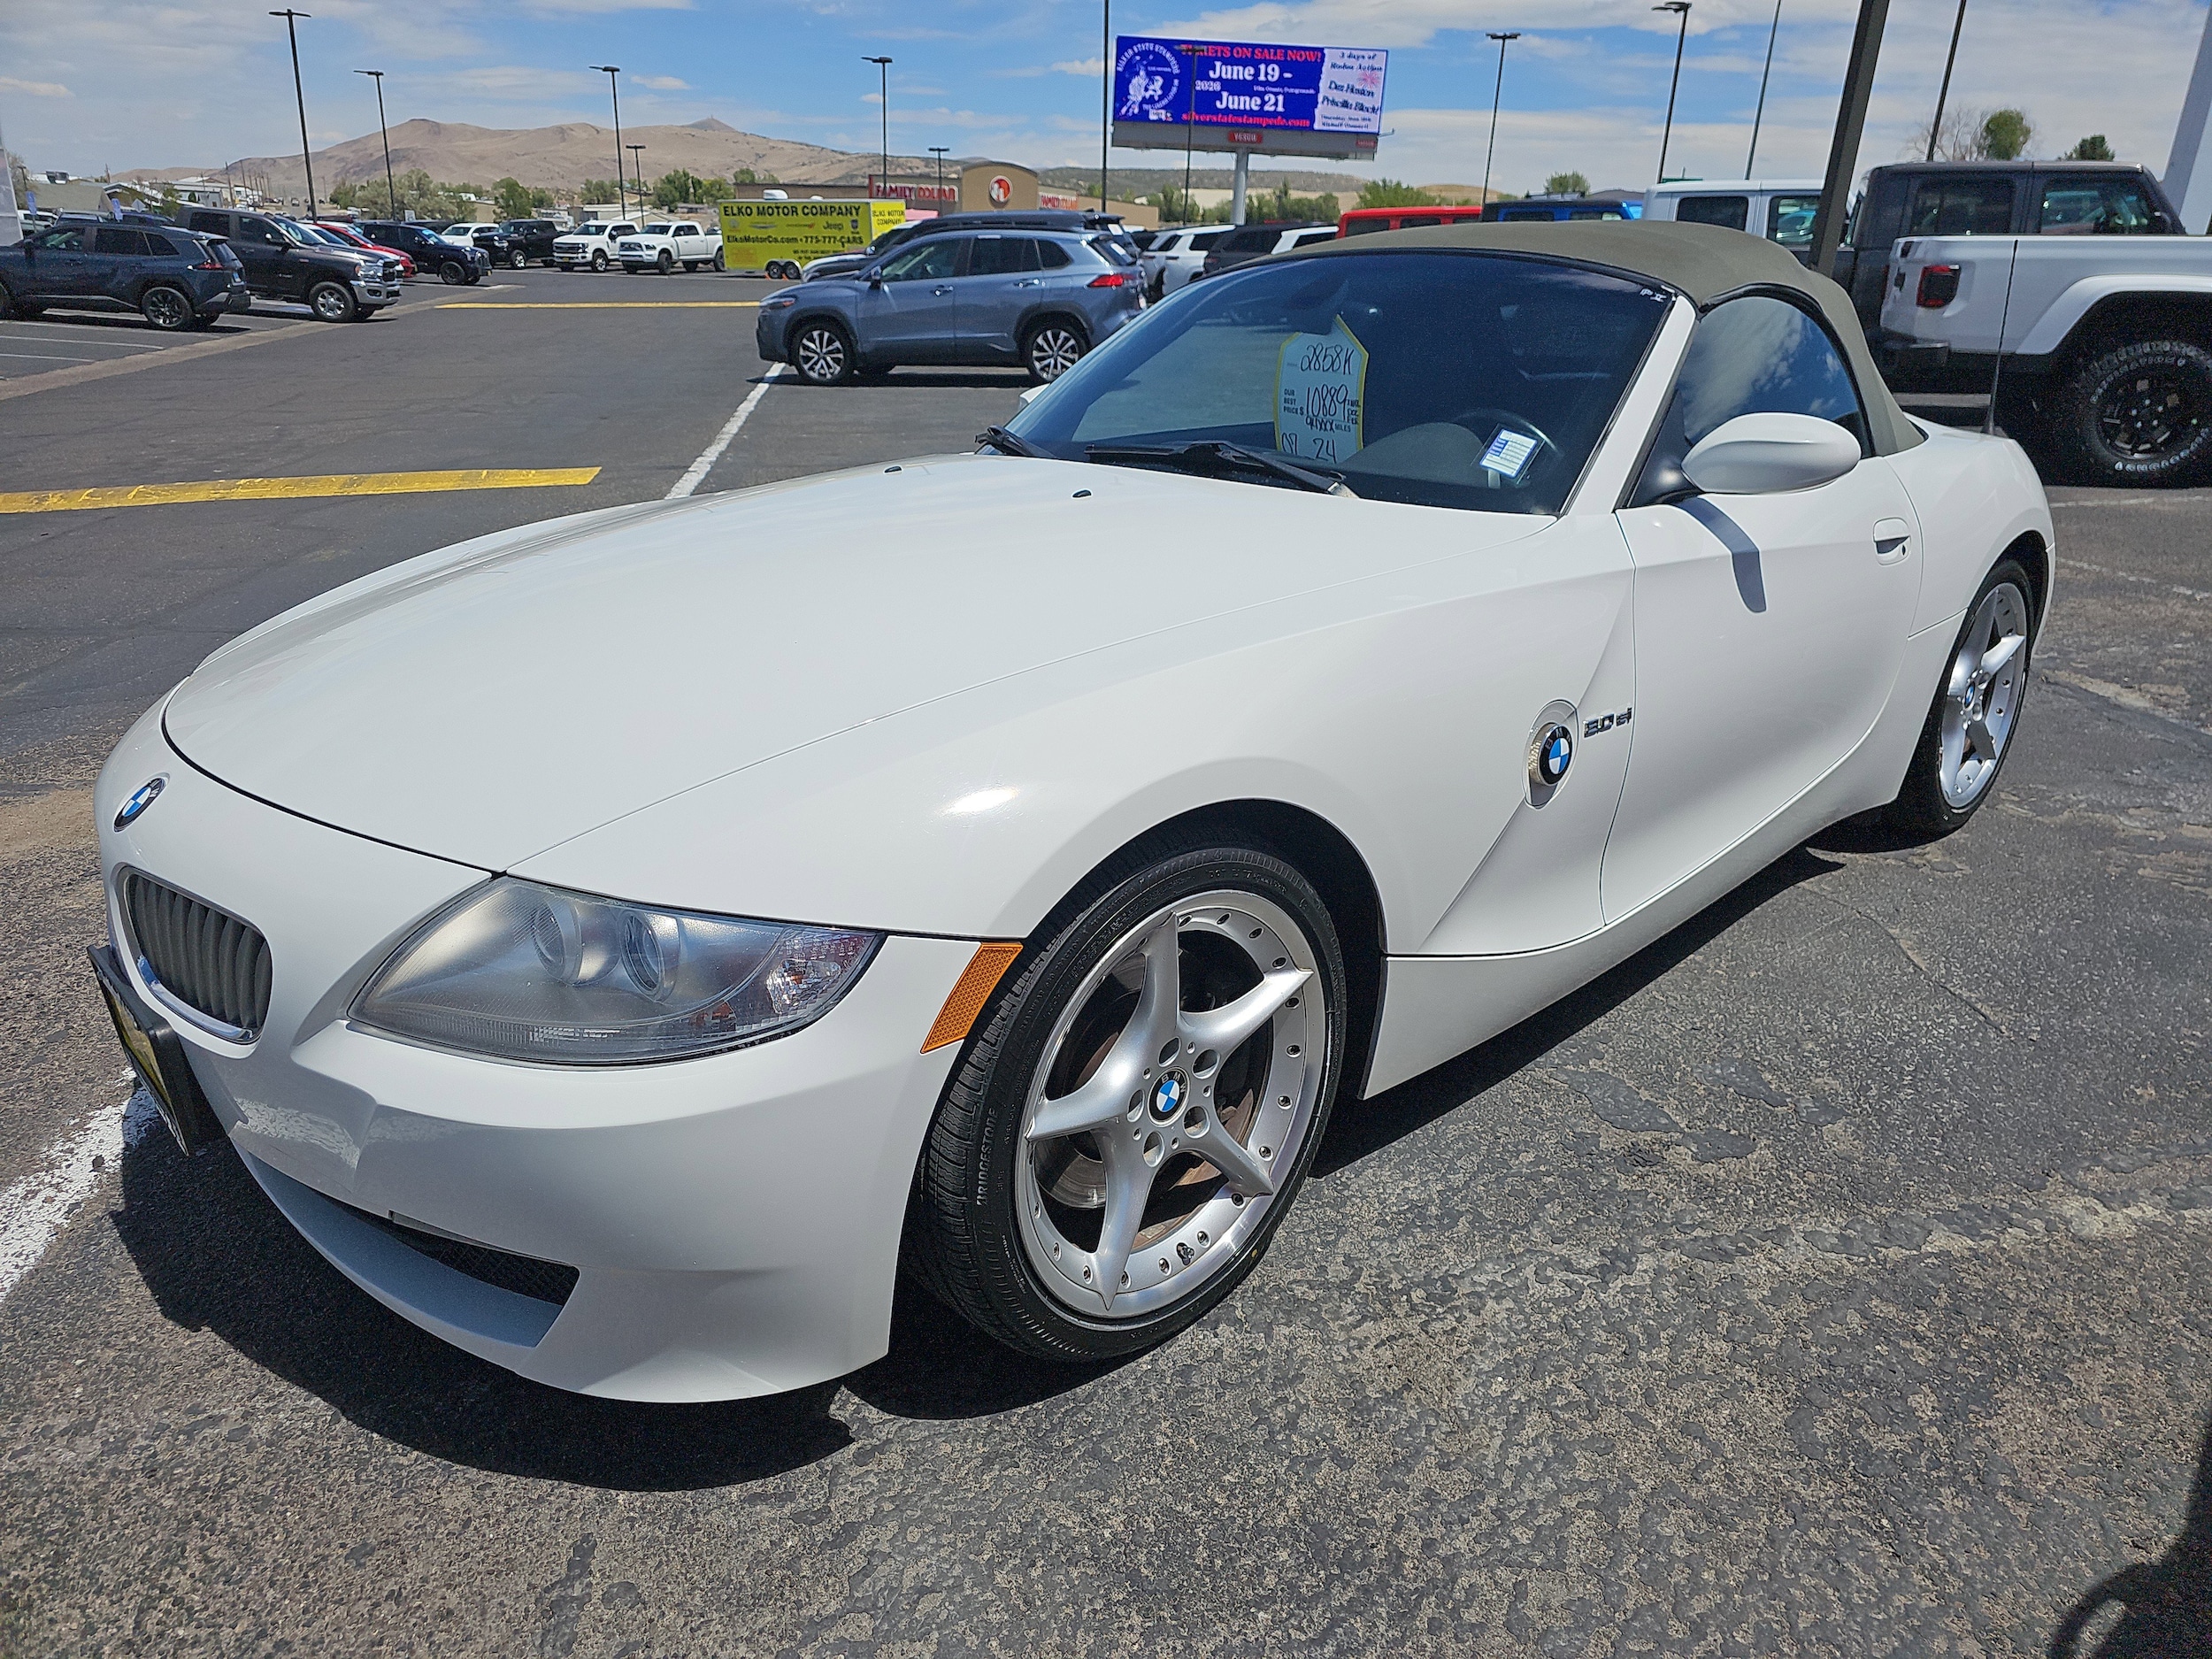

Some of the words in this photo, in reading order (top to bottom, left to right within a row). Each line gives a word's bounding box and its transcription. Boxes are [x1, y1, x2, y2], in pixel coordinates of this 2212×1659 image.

[1181, 44, 1231, 58] TETS
[1233, 47, 1252, 58] ON
[1254, 48, 1285, 61] SALE
[1287, 50, 1322, 63] NOW!
[1209, 60, 1255, 81] June
[1257, 63, 1280, 82] 19
[1194, 80, 1222, 92] 2026
[1215, 91, 1262, 111] June
[1263, 93, 1286, 112] 21
[875, 182, 917, 200] FAMILY
[723, 205, 753, 217] ELKO
[757, 205, 799, 217] MOTOR
[802, 205, 861, 217] COMPANY
[1306, 384, 1348, 421] 10889
[976, 1107, 997, 1206] BRIDGESTONE
